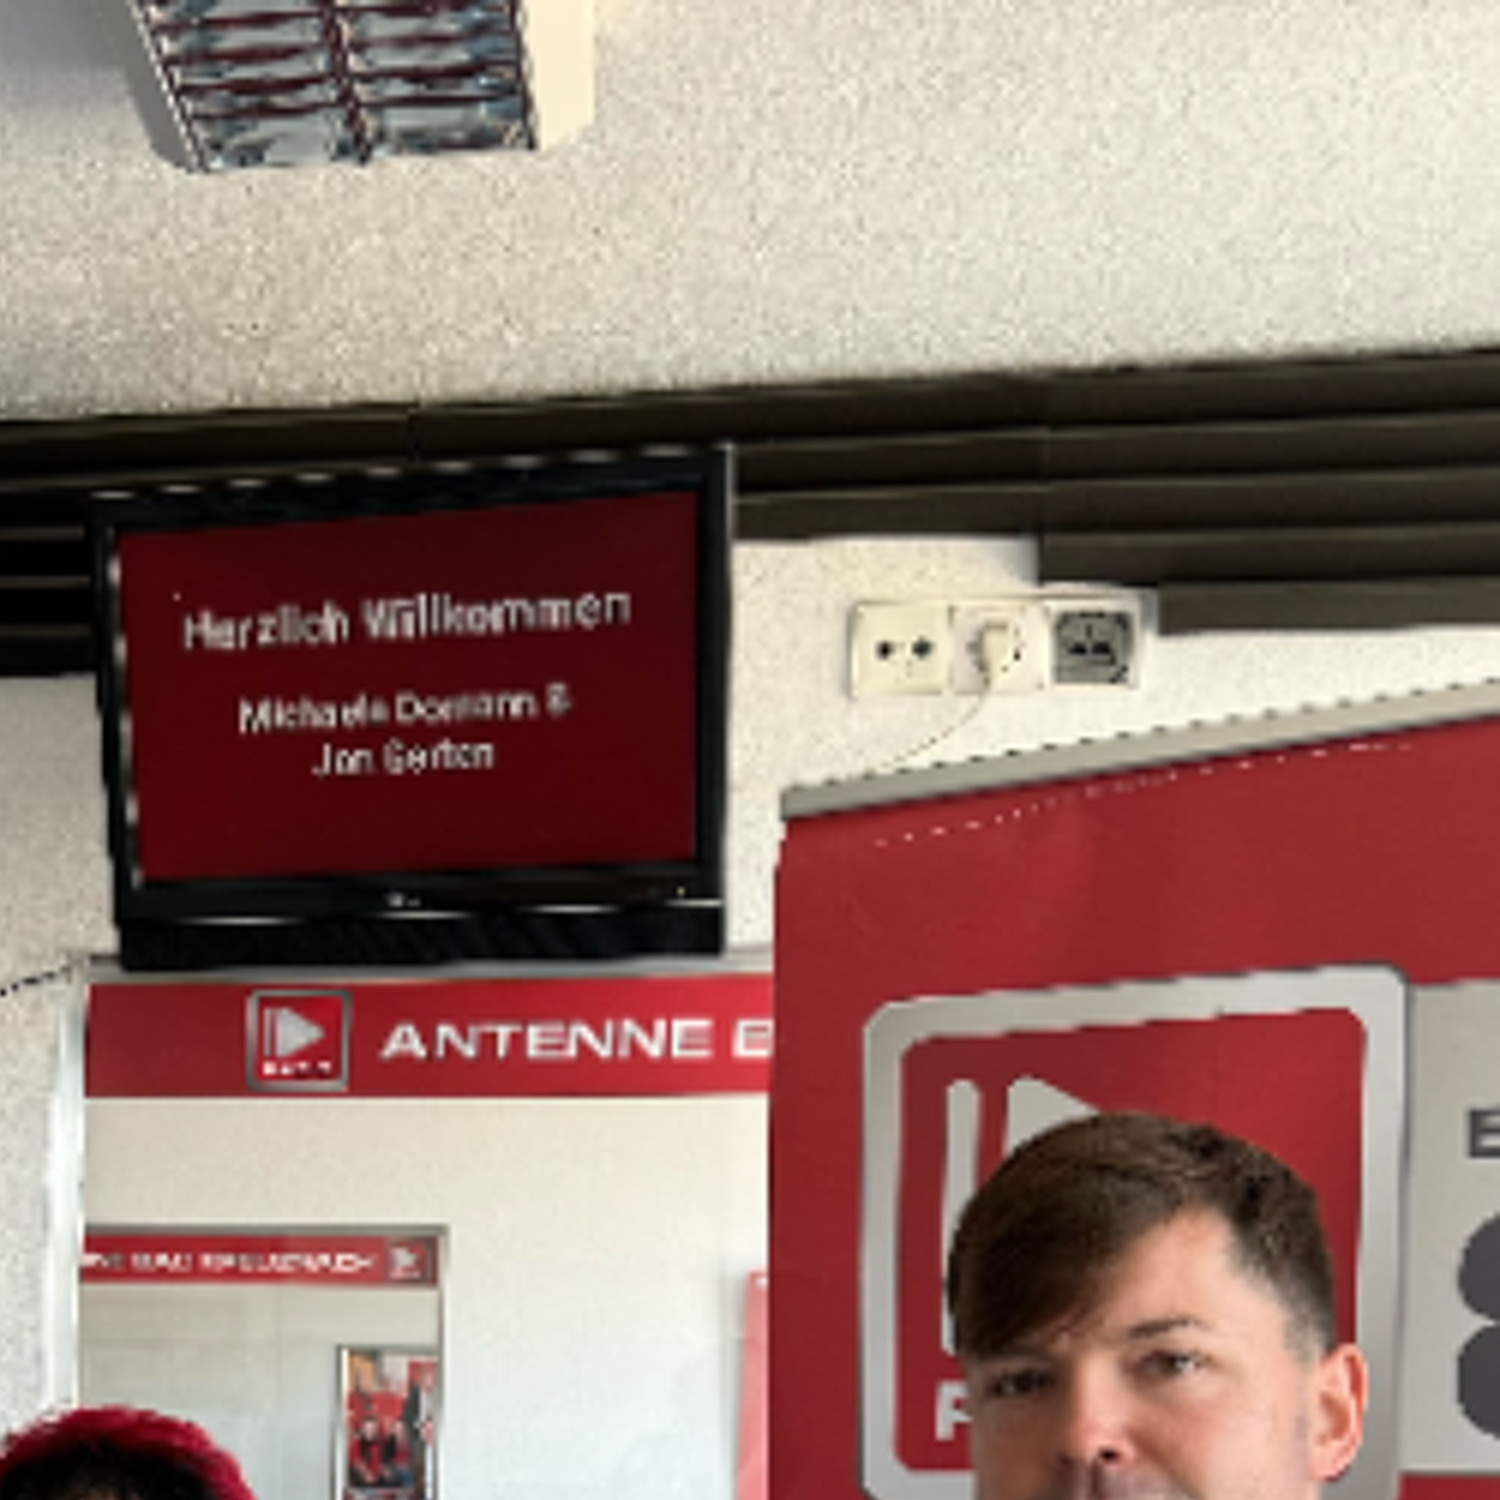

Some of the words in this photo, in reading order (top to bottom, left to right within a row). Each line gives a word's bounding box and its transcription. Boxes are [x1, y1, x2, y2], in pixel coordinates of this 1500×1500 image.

[184, 600, 349, 650] Herzlich
[361, 592, 631, 640] Willkommen
[379, 1019, 713, 1059] ANTENNE
